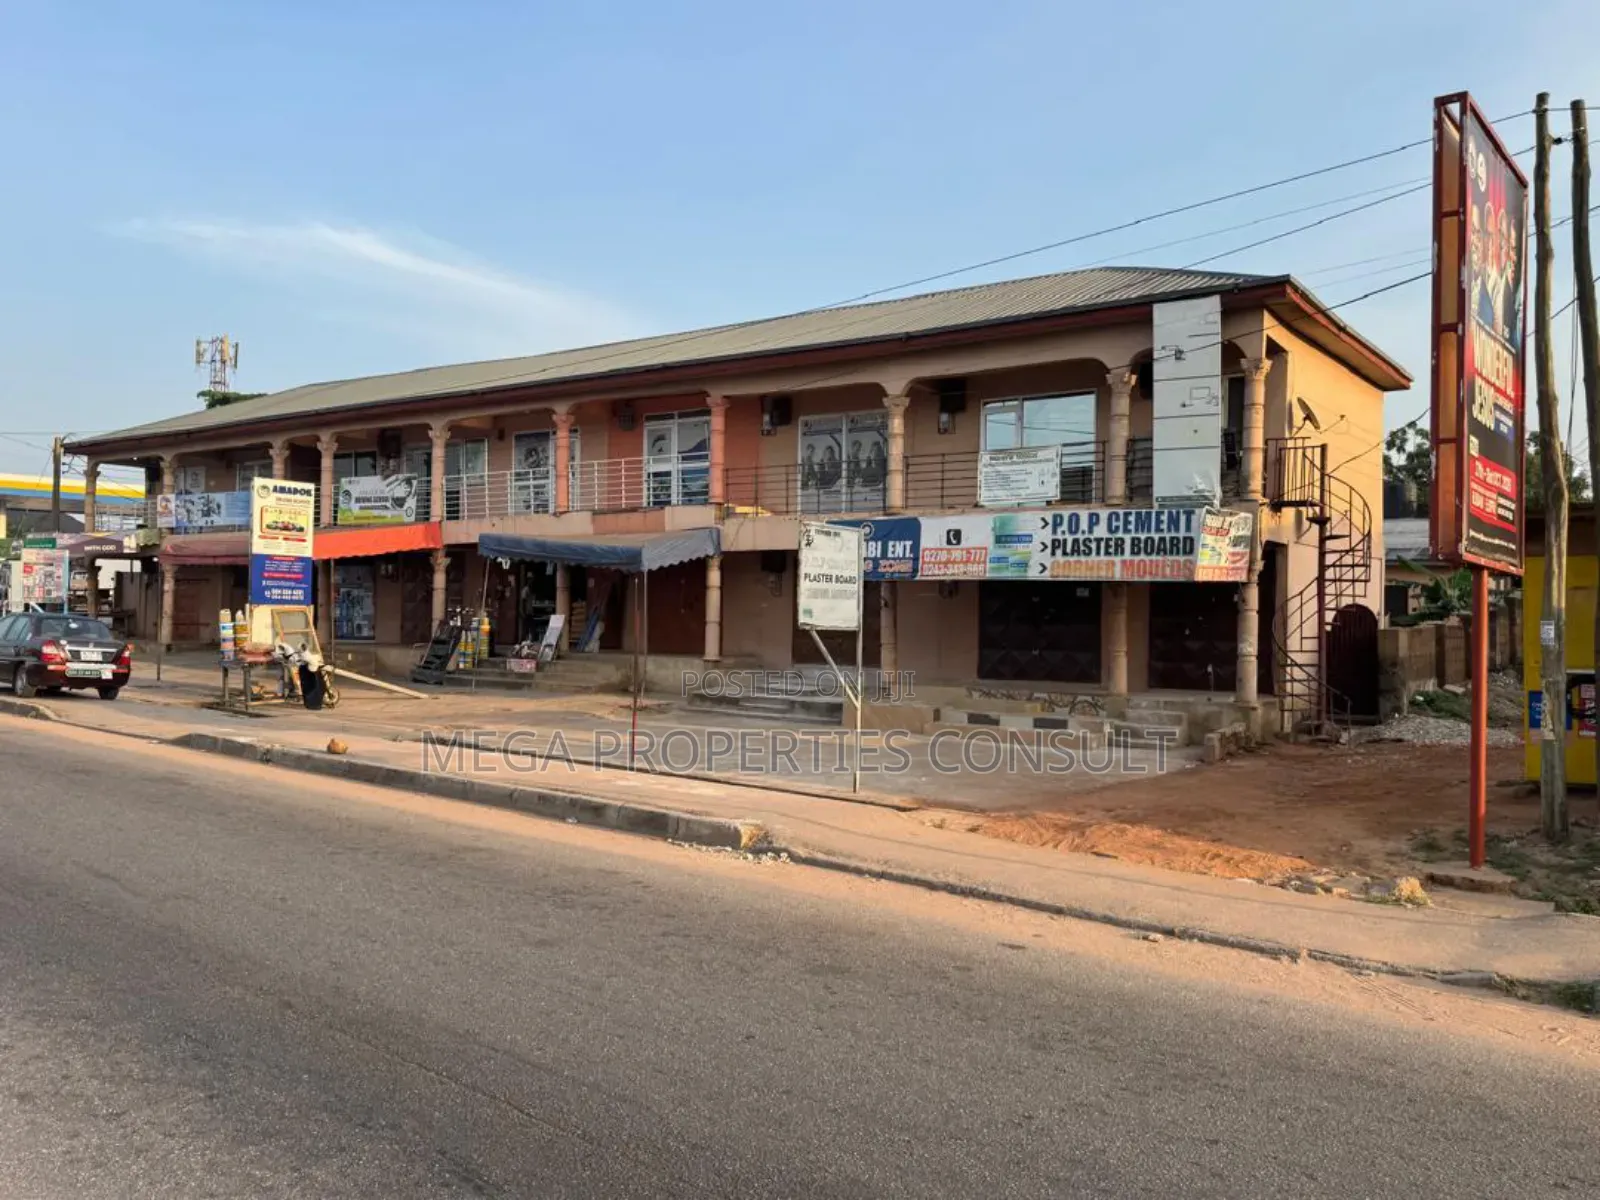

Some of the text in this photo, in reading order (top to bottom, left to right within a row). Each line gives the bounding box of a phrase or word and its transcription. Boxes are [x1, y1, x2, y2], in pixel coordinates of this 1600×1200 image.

[1051, 512, 1100, 536] P.O.P
[1107, 509, 1196, 536] CEMENT
[887, 541, 914, 558] ENT.
[1051, 536, 1125, 557] PLASTER
[1130, 535, 1195, 556] BOARD
[804, 573, 857, 585] PLASTER BOARD
